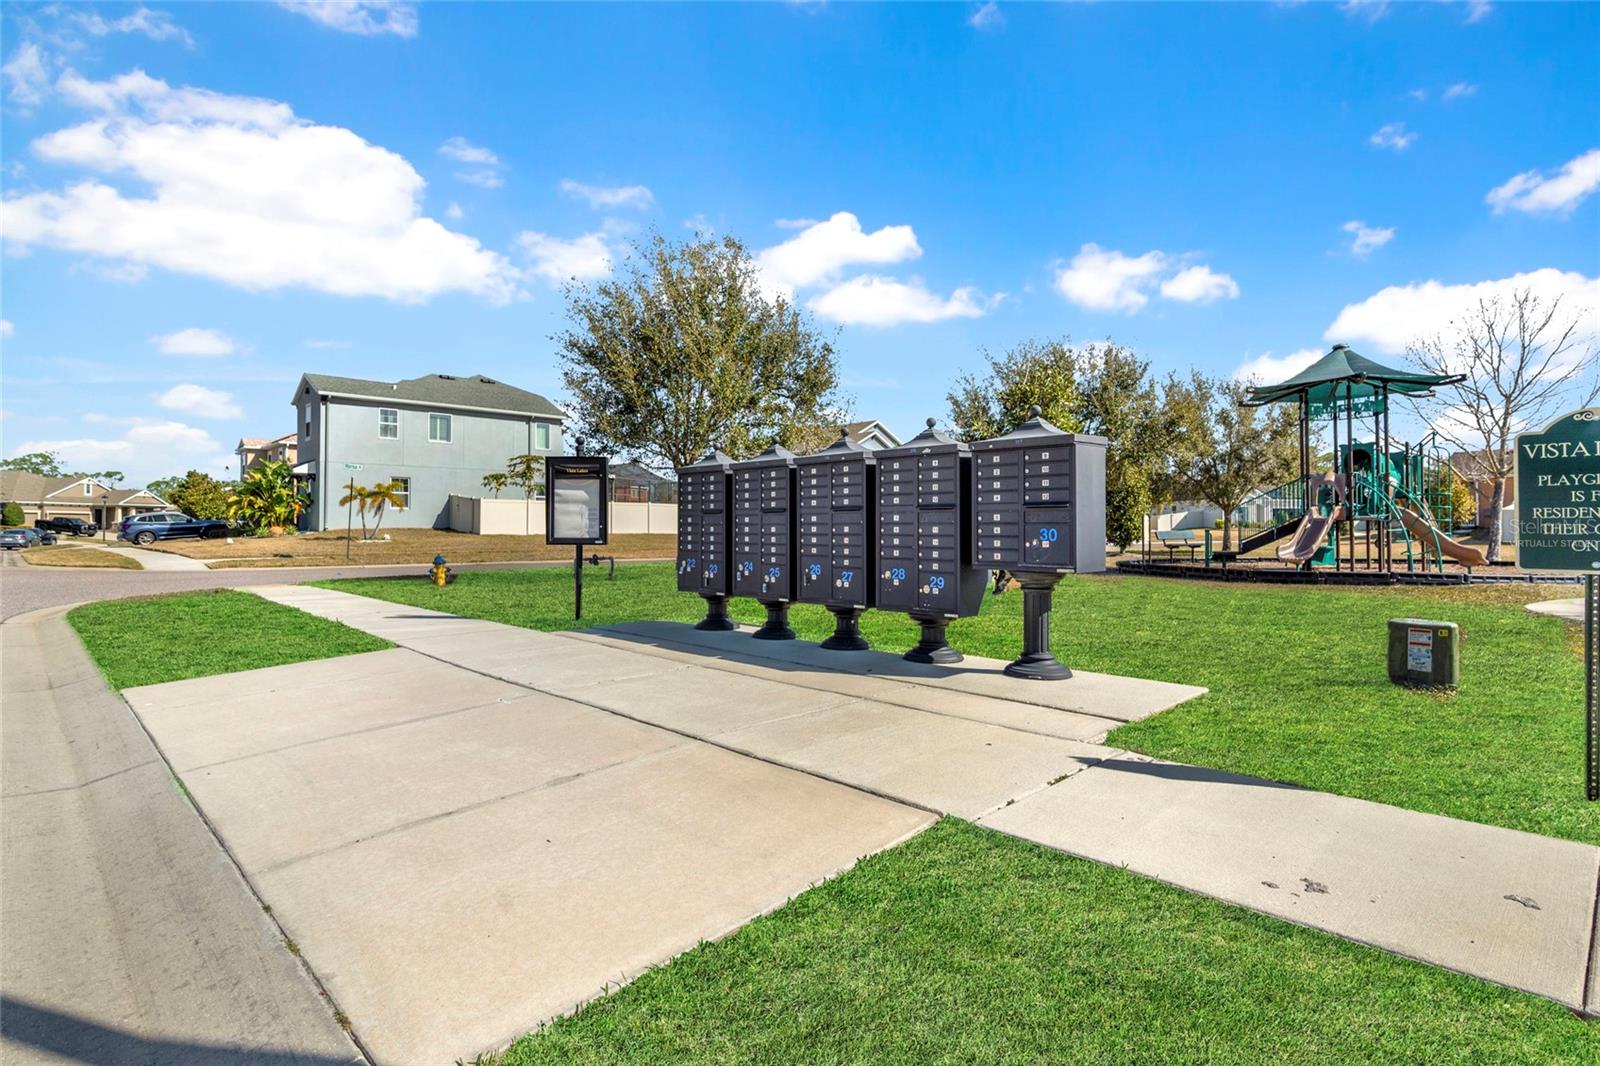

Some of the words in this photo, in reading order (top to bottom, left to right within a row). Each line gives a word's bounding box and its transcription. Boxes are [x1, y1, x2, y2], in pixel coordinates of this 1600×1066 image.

[1522, 442, 1591, 459] VISTA
[1571, 490, 1585, 502] IS
[1531, 507, 1600, 519] RESIDEN
[1040, 528, 1057, 541] 30
[1543, 523, 1588, 535] THEIR
[709, 564, 718, 574] 23
[744, 561, 753, 571] 24
[769, 567, 780, 577] 25
[809, 564, 821, 576] 26
[841, 571, 853, 582] 27
[892, 568, 906, 580] 28
[930, 576, 945, 589] 29
